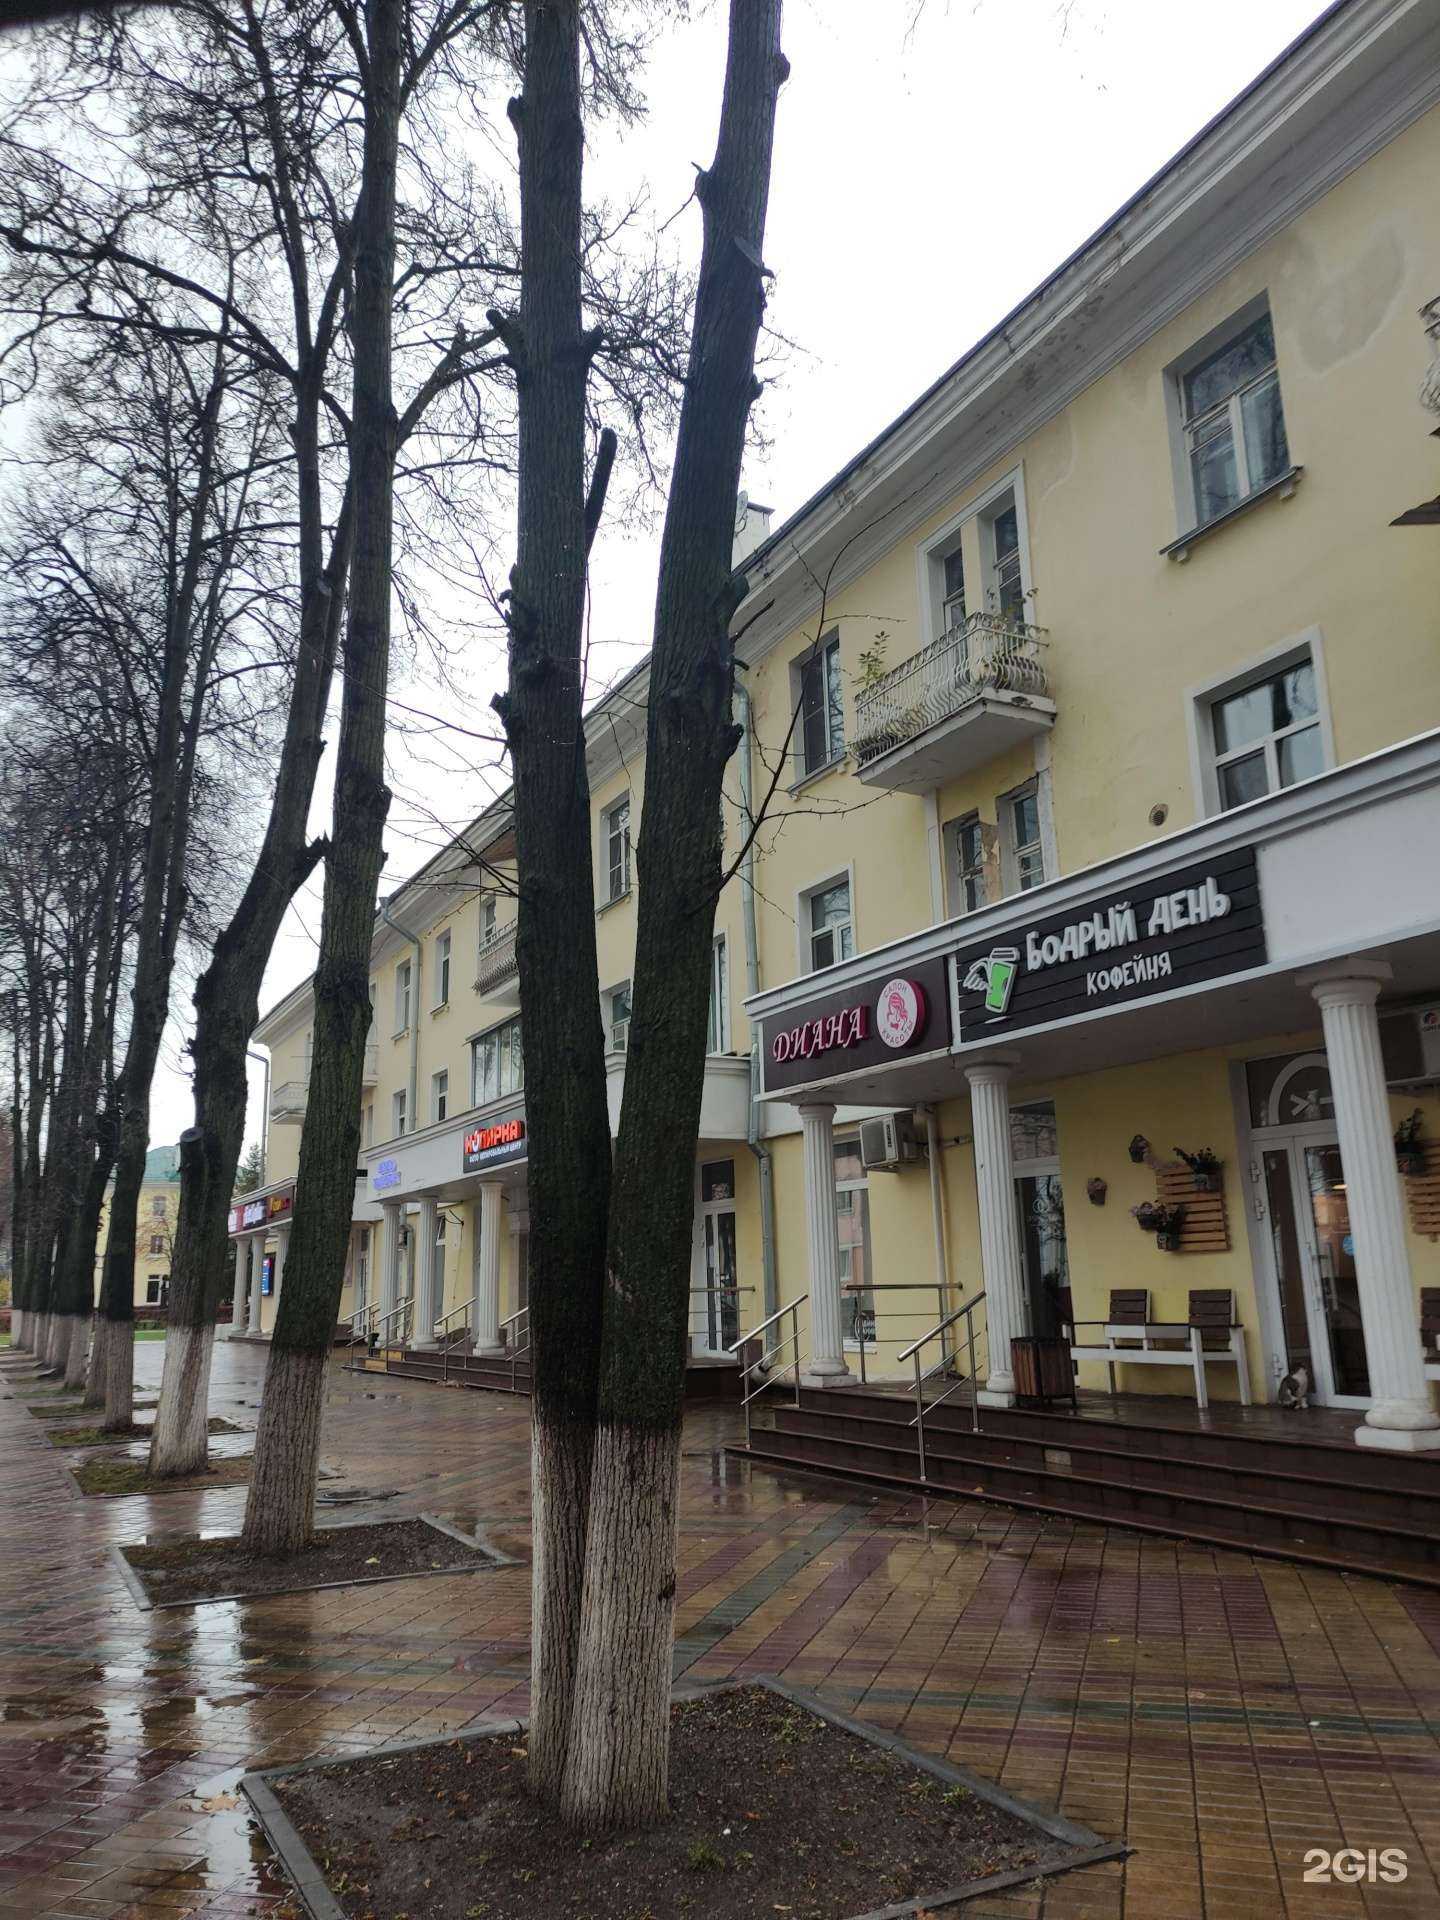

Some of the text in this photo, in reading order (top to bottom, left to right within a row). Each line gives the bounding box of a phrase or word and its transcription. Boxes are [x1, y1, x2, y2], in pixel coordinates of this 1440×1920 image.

[1026, 876, 1231, 971] БОДРЫЙ ДЕНЬ
[884, 982, 908, 998] САЛОН
[1086, 951, 1173, 996] КОФЕЙНЯ
[772, 1005, 865, 1063] ДИАНА
